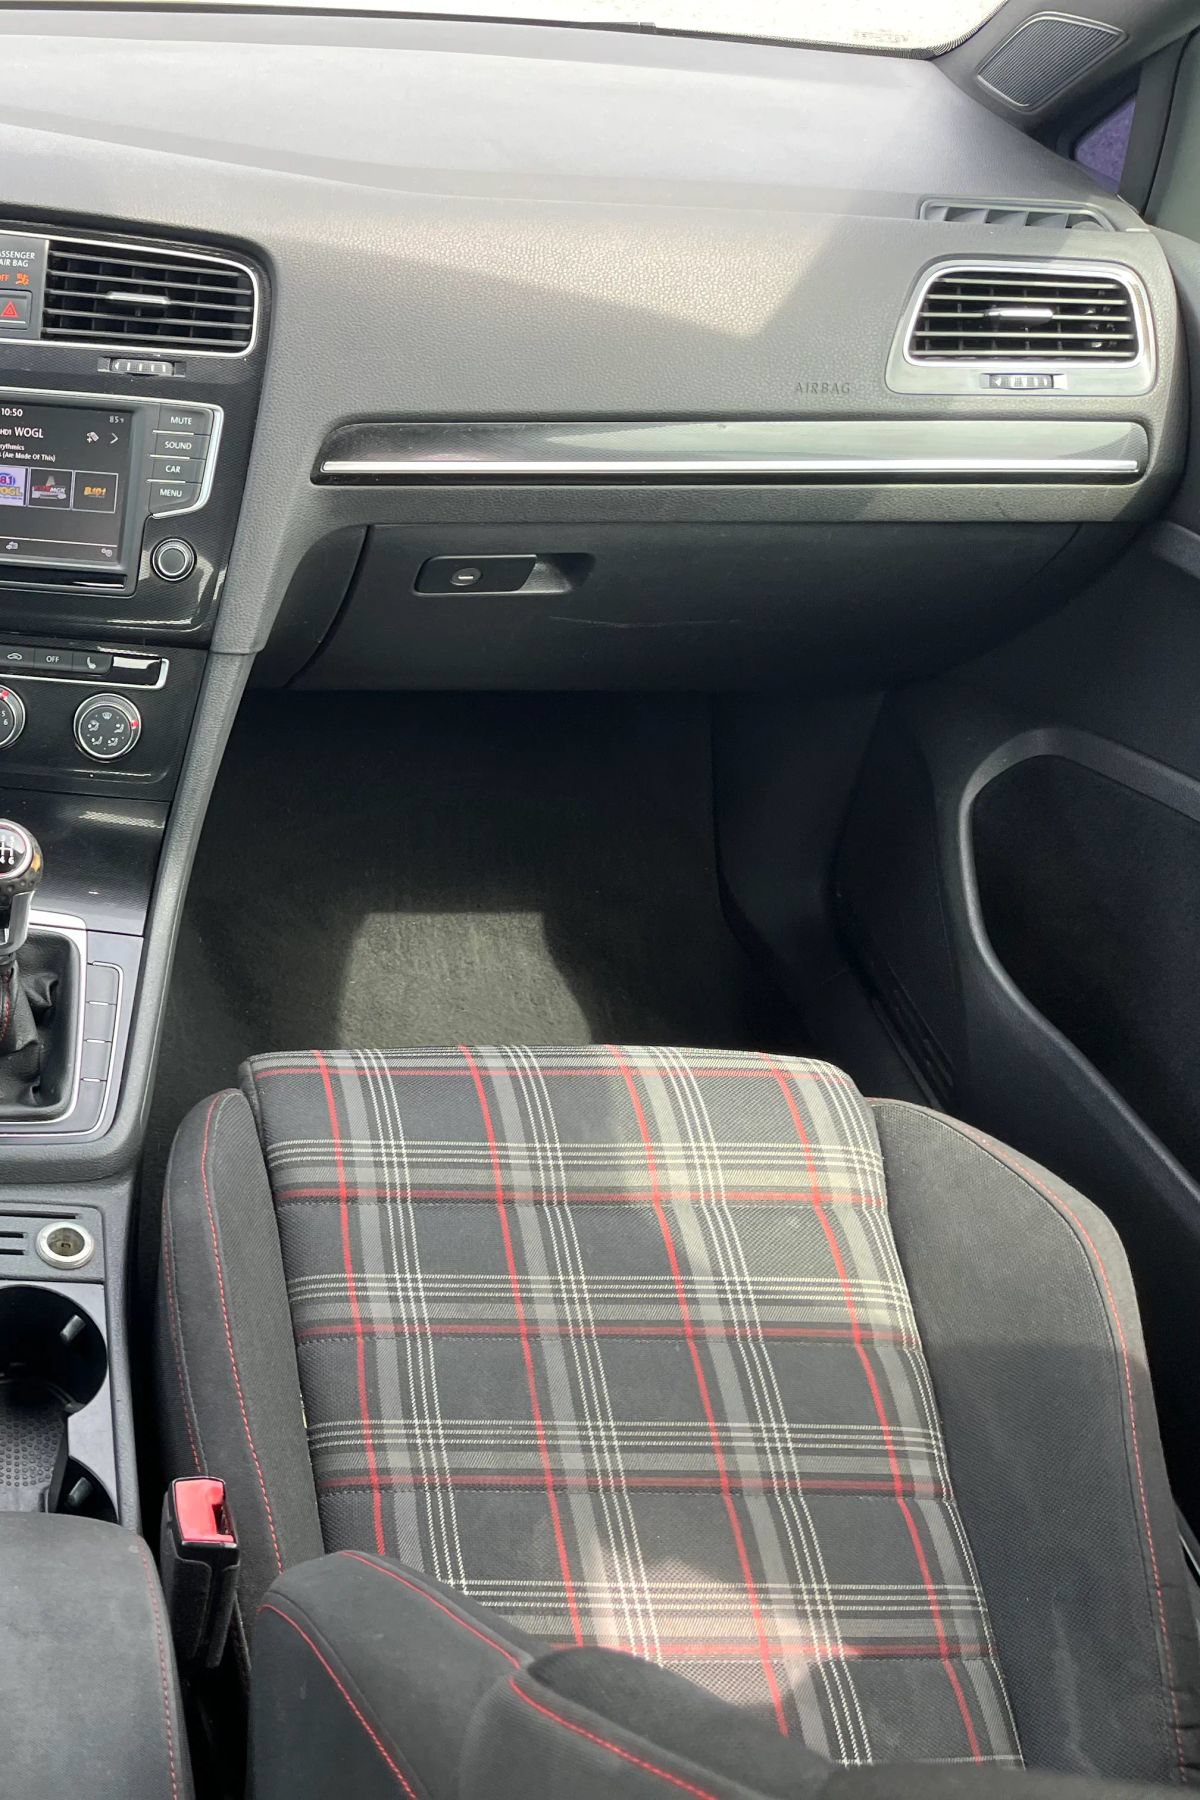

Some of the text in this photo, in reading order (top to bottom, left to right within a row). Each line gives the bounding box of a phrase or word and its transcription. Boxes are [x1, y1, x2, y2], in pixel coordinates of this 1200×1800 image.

[795, 382, 850, 394] AIRBAG
[0, 408, 23, 417] 10:50
[170, 416, 192, 426] MUTE
[14, 427, 44, 438] WOGL
[164, 440, 192, 451] SOUND
[165, 464, 181, 474] CAR
[159, 487, 183, 498] MENU
[46, 655, 60, 664] OFF
[0, 856, 6, 864] 4
[8, 857, 15, 865] 6
